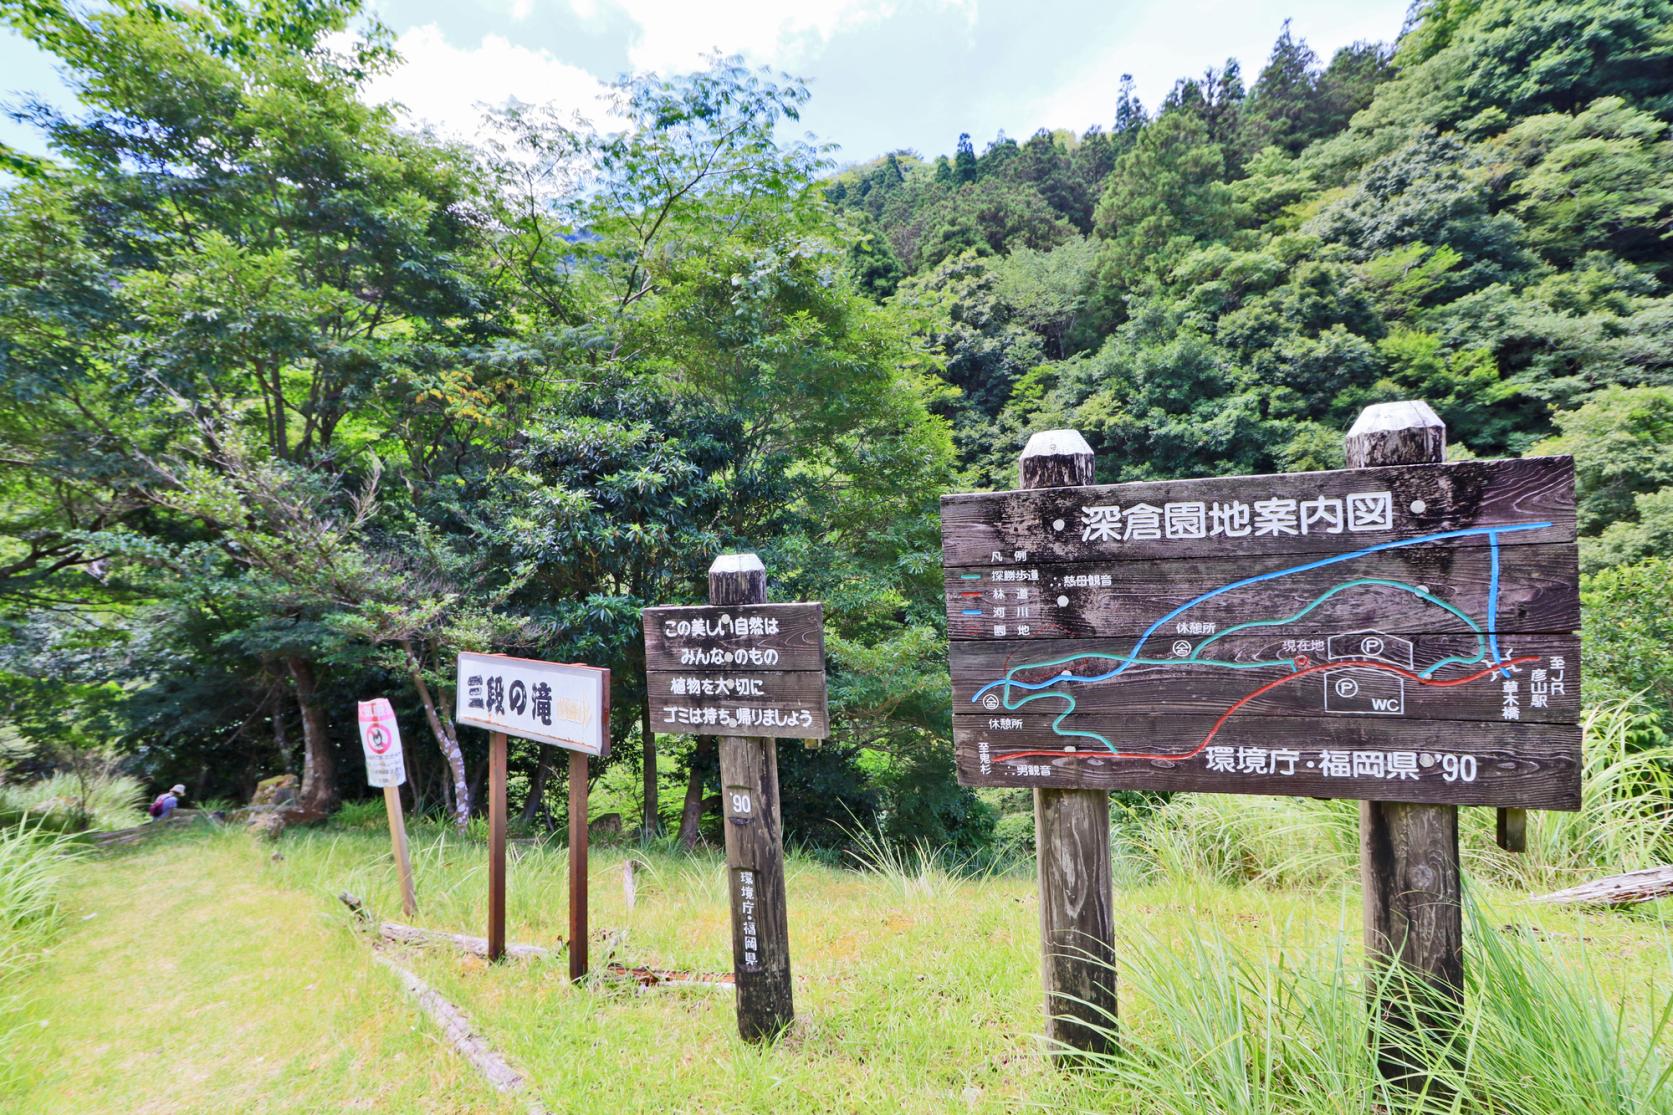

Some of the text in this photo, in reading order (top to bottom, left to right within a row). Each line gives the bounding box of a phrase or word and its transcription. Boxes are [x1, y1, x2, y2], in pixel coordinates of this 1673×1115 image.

[1081, 490, 1394, 542] 深倉園地案内図
[991, 550, 1027, 562] 凡例
[991, 569, 1040, 582] 探勝歩道
[1063, 574, 1113, 588] 慈母観音
[992, 588, 1028, 600] 林道
[993, 606, 1029, 618] 河川
[665, 617, 780, 638] この美しい自然は
[993, 624, 1031, 637] 園地
[1176, 621, 1217, 635] 休憩所
[1282, 639, 1325, 652] 現在地
[680, 648, 779, 666] みんなのもの
[670, 677, 765, 696] 植物を大切に
[1530, 668, 1548, 708] 彦山駅
[1371, 698, 1400, 712] WC
[1502, 680, 1521, 720] 草木橋
[663, 706, 813, 728] ゴミは持ち帰りましょう
[988, 717, 1023, 730] 休憩所
[977, 742, 992, 776] 至鬼杉
[1205, 745, 1421, 781] 環境庁・福岡県
[1016, 764, 1052, 777] 男観音
[740, 871, 759, 967] 環境庁・福岡県
